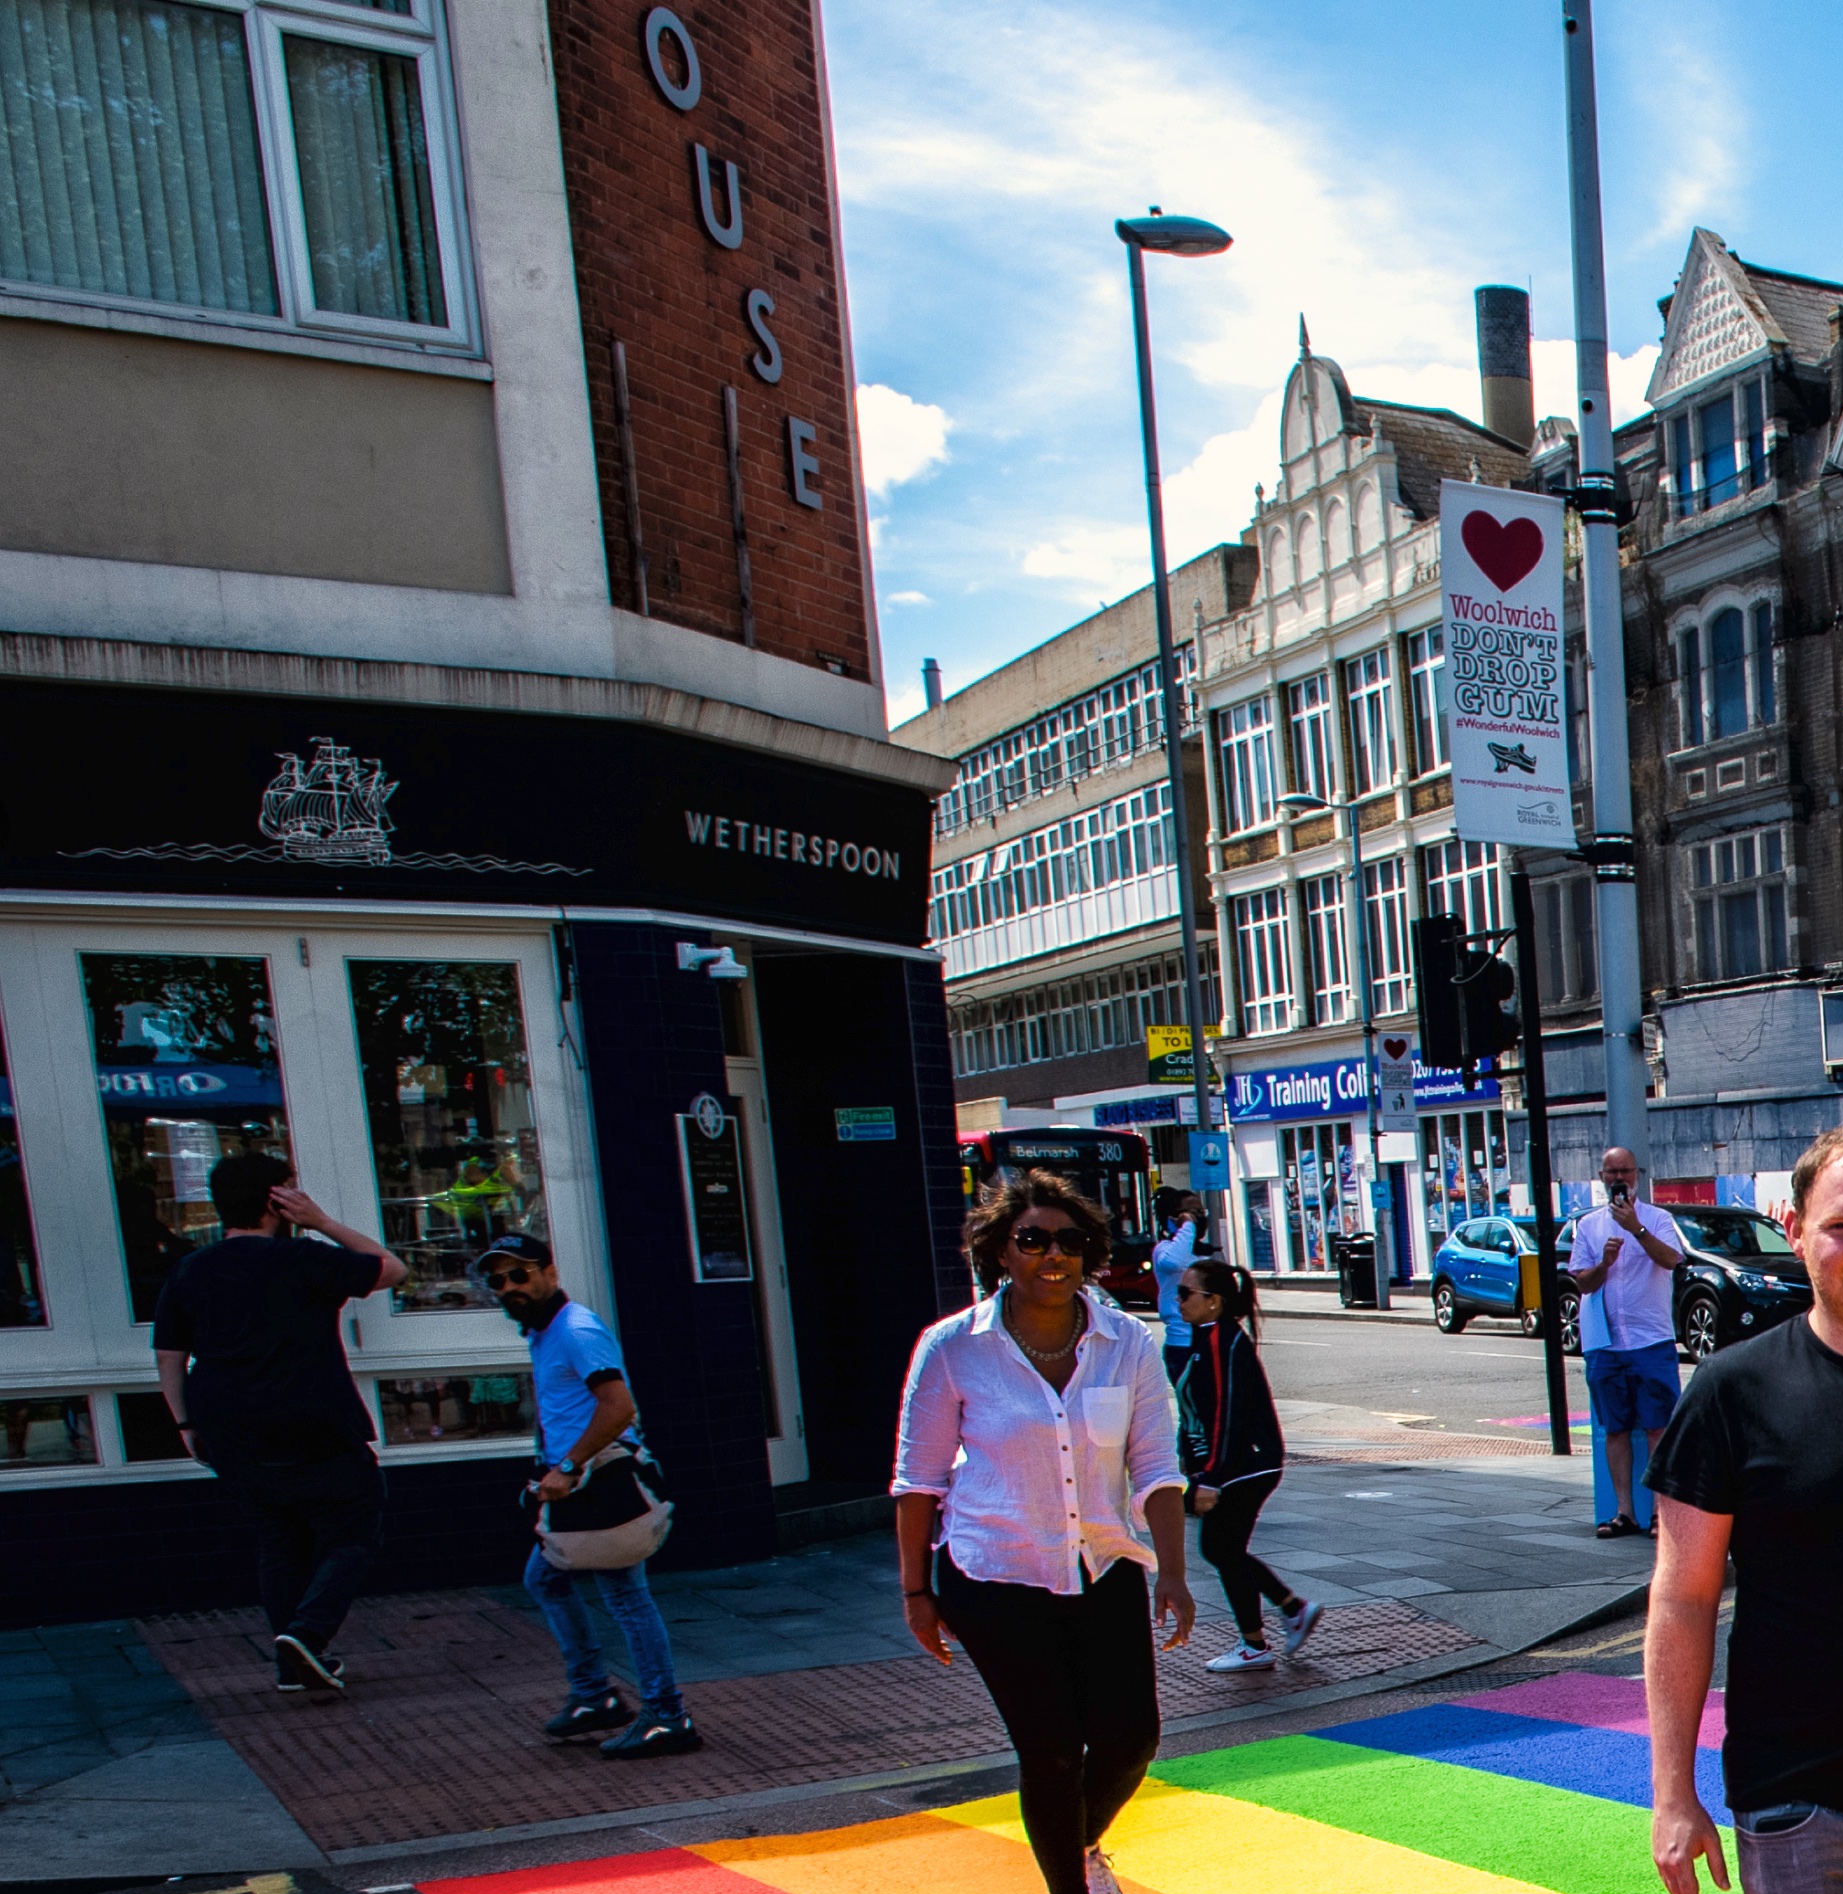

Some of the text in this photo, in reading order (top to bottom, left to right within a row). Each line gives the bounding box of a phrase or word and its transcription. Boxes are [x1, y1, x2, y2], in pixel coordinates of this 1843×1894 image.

[1449, 594, 1558, 632] Woolwich
[1451, 622, 1558, 662] DON'T
[1453, 651, 1557, 691] DROP
[1455, 681, 1560, 724] GUM
[1456, 717, 1561, 739] #WonderfulWoolwich
[684, 810, 900, 881] WETHERSPOON
[1162, 1036, 1181, 1047] TO
[1265, 1071, 1332, 1111] Training
[1016, 1143, 1123, 1163] Belmarsh 380
